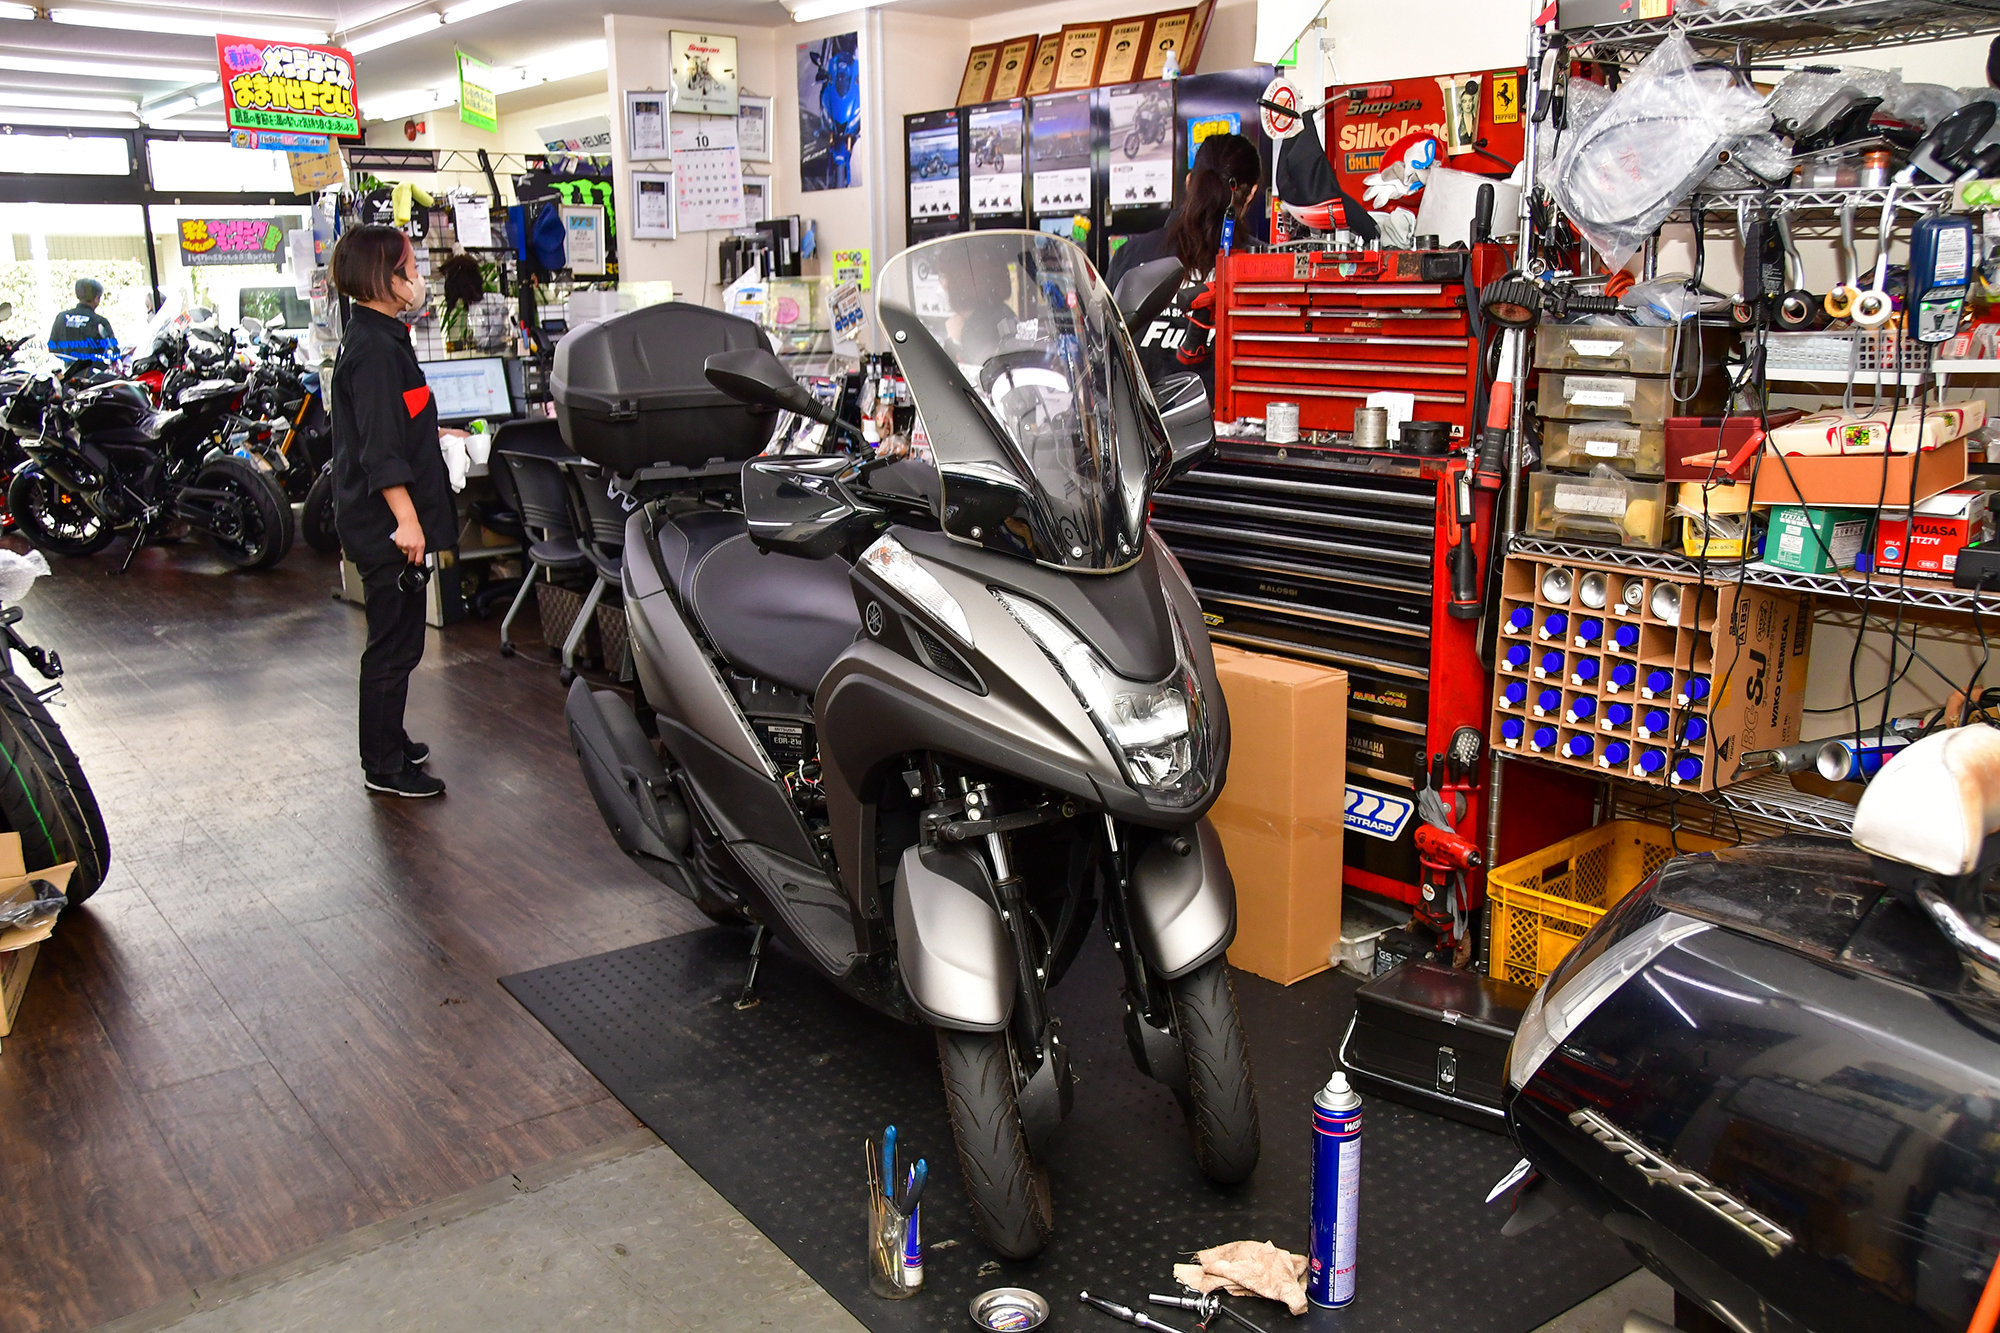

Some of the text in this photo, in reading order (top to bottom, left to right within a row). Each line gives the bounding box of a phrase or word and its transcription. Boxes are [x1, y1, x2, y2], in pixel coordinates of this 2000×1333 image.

[1120, 25, 1140, 34] YAMAHA
[1165, 19, 1186, 28] YAMAHA
[1074, 32, 1097, 40] YAMAHA
[261, 46, 354, 90] メンテナンス
[1345, 99, 1422, 118] Snap-on
[695, 136, 710, 148] 10
[1347, 154, 1383, 171] ÖHLIN
[181, 220, 208, 240] 秋
[1140, 320, 1216, 350] Fu!
[1911, 524, 1958, 537] YUASA
[1258, 584, 1298, 597] MALOSSI
[1771, 614, 1791, 728] WAKO CHEMICAL
[1353, 691, 1408, 709] MALOSSI
[1353, 737, 1385, 755] YAMAHA
